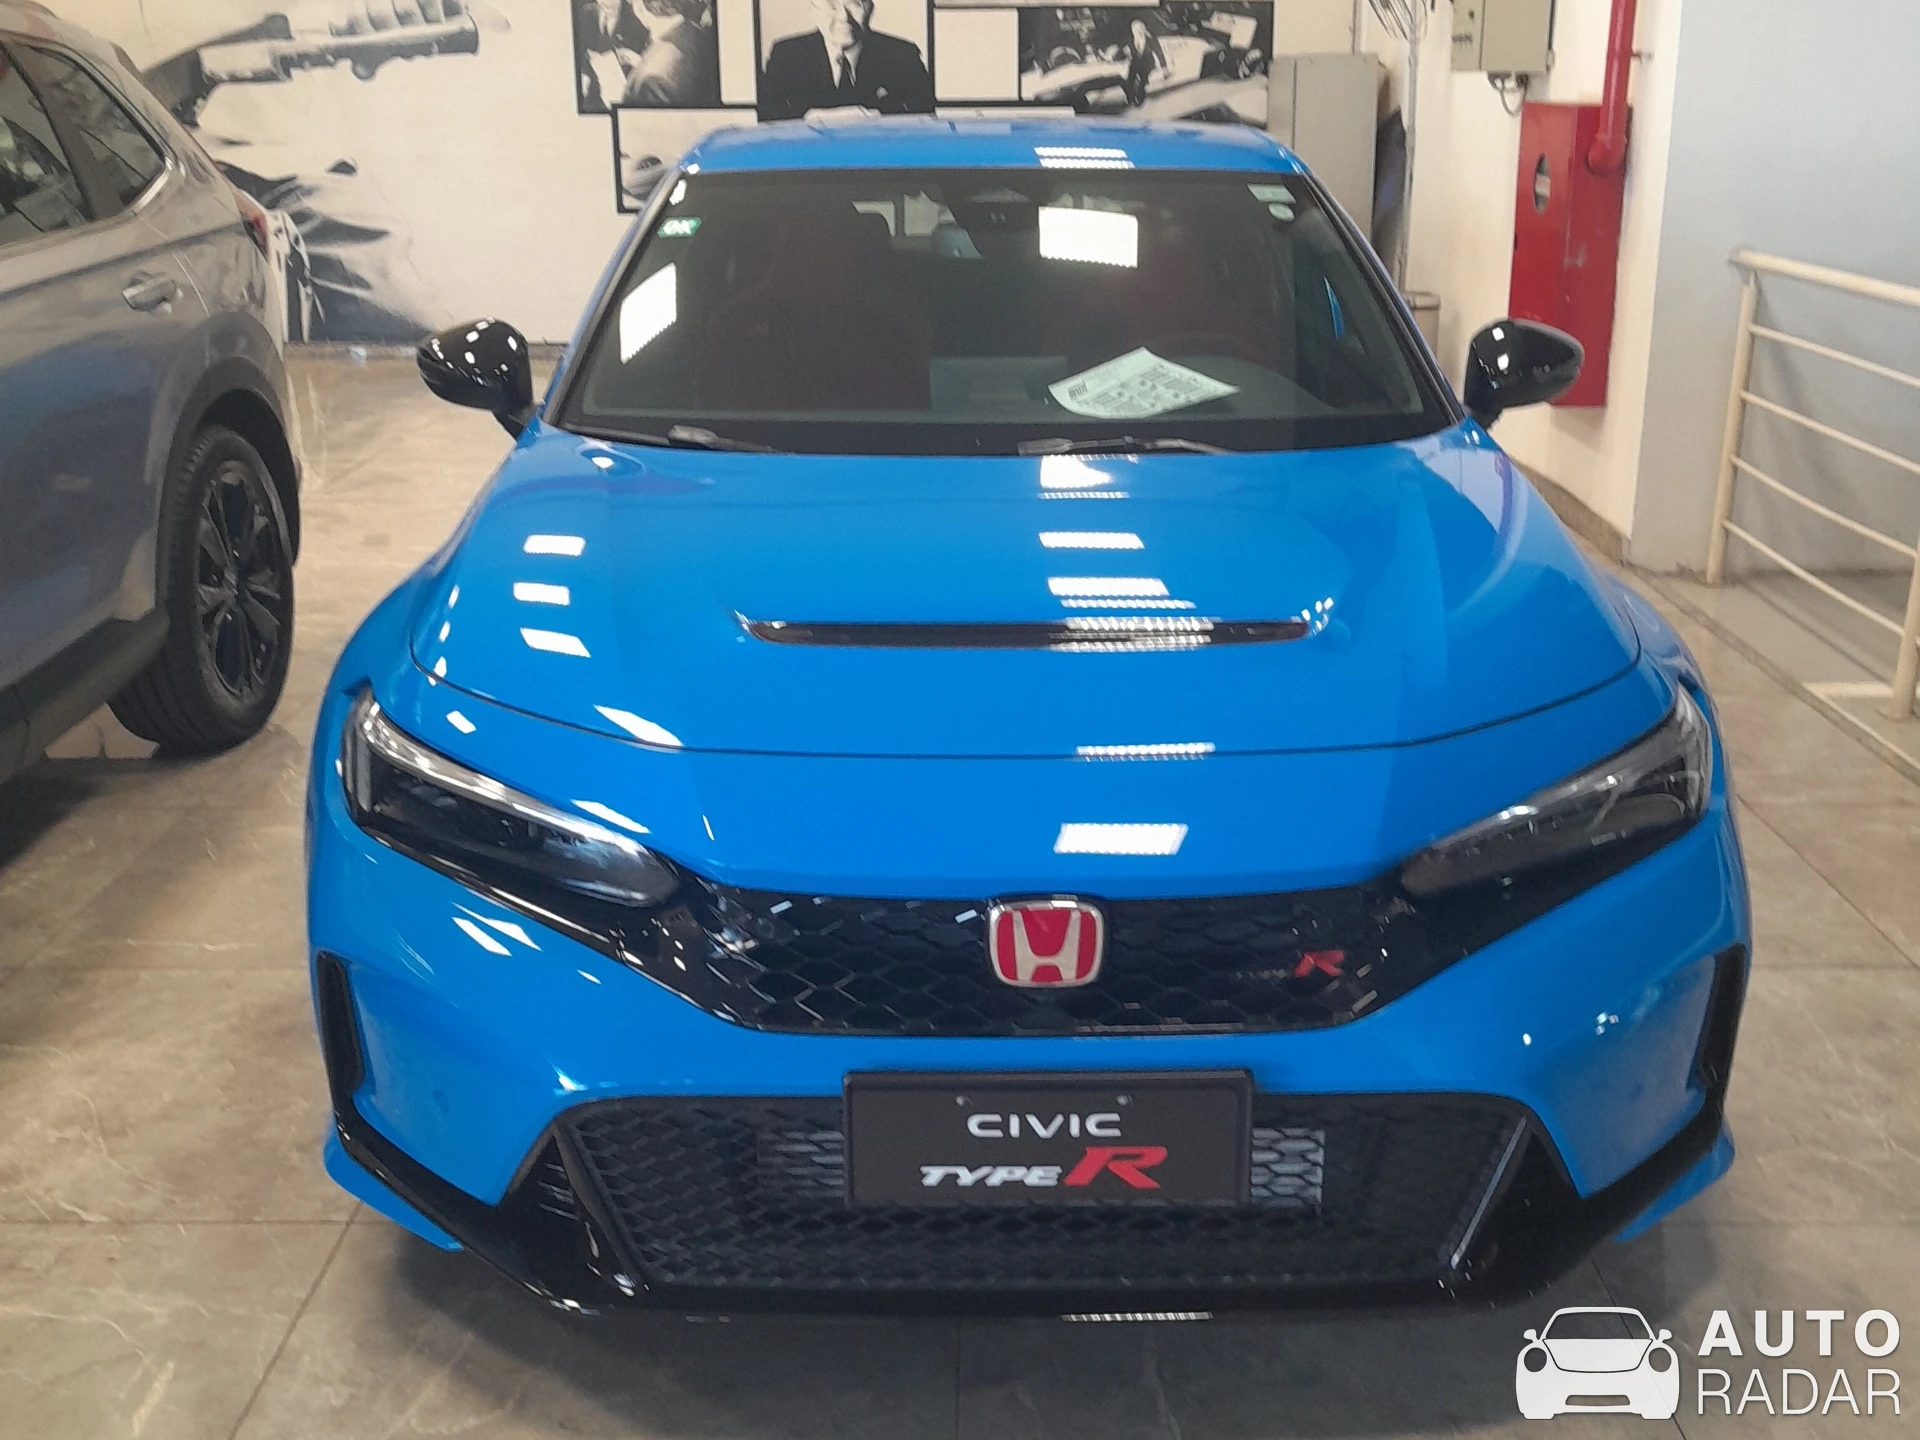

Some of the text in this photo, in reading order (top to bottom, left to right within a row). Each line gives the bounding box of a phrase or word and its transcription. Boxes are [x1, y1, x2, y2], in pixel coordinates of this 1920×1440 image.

[966, 1112, 1122, 1138] CIVIC
[919, 1145, 1168, 1189] TYPE R
